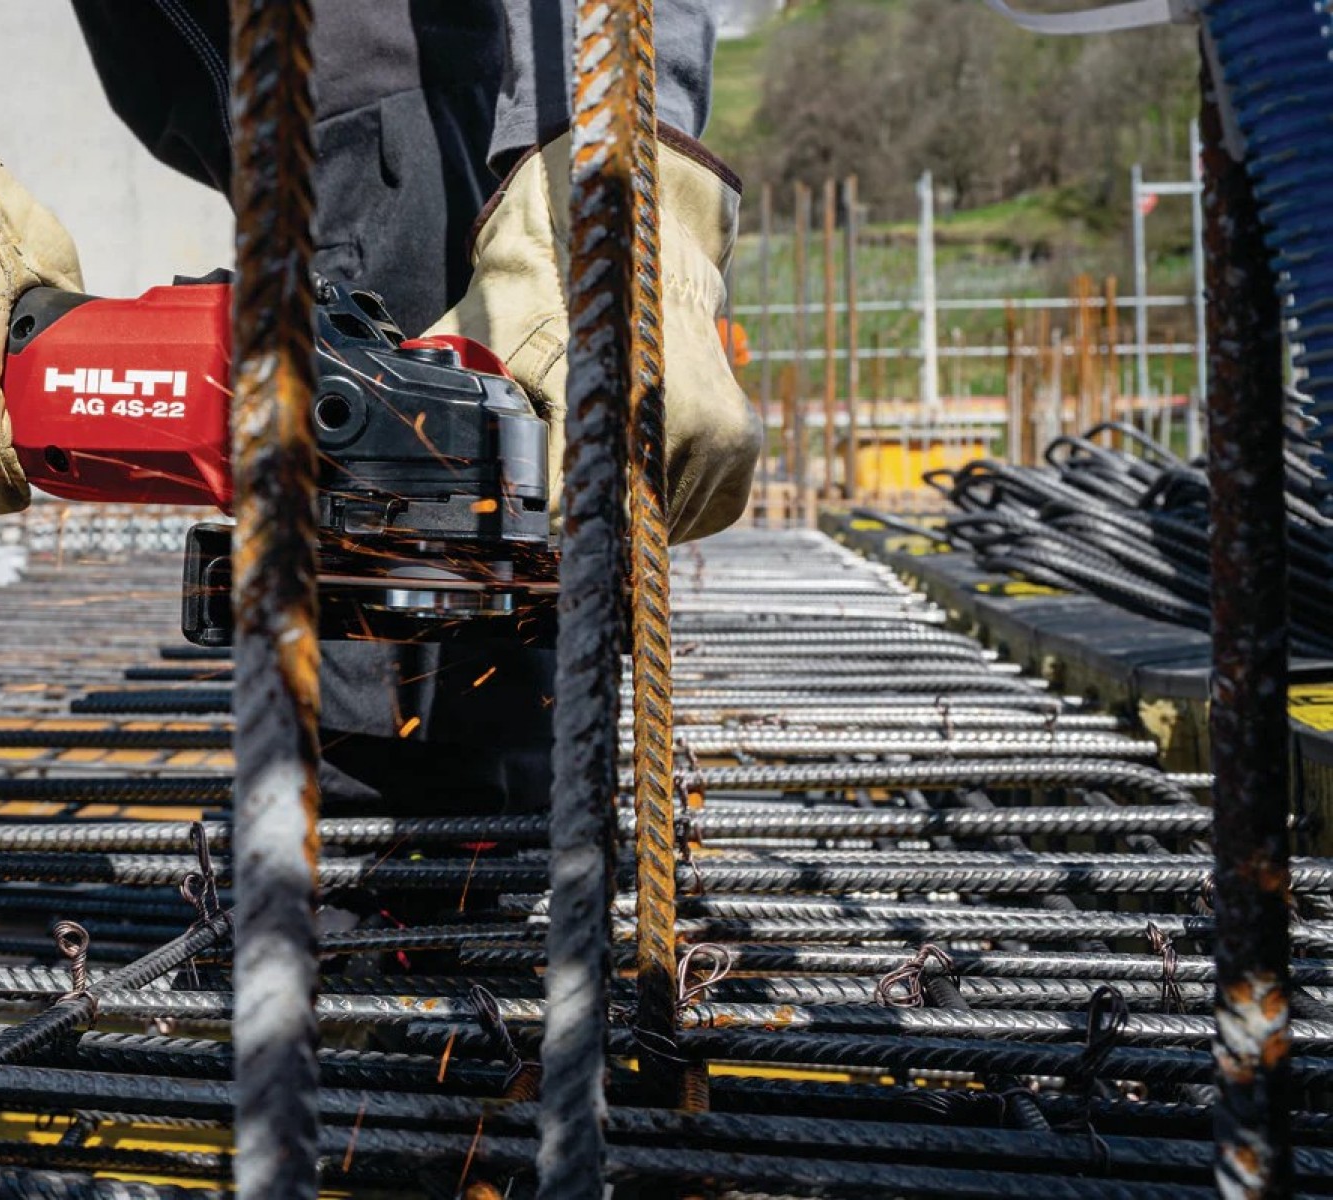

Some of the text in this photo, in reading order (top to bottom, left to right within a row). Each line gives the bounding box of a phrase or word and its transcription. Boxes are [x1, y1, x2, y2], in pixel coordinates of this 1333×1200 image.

[44, 367, 187, 397] HILTI
[70, 397, 185, 418] AG 4S-22
